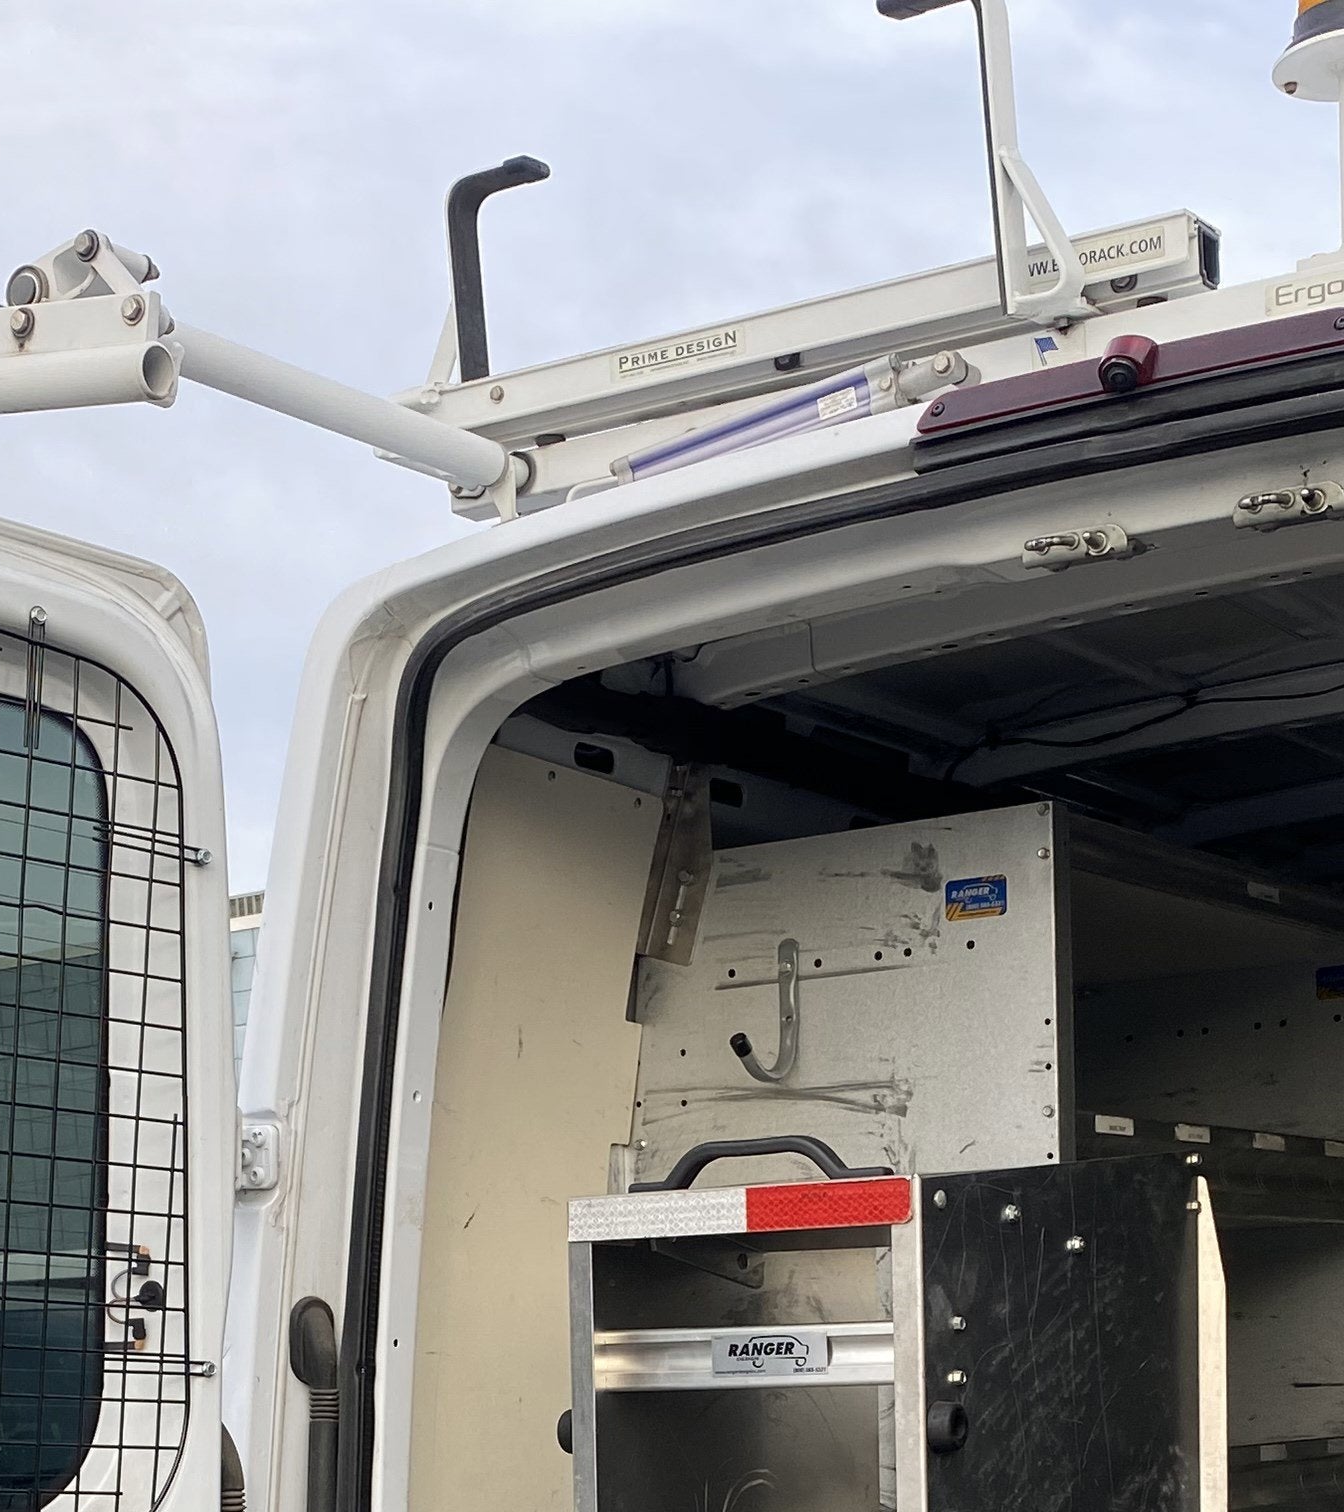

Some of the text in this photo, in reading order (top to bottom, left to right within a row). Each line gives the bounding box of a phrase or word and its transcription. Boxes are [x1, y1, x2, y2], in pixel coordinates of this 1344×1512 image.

[618, 350, 669, 370] PRIME
[676, 330, 738, 357] DESIGN
[951, 887, 990, 899] RANGER
[728, 1342, 795, 1357] RANGER
